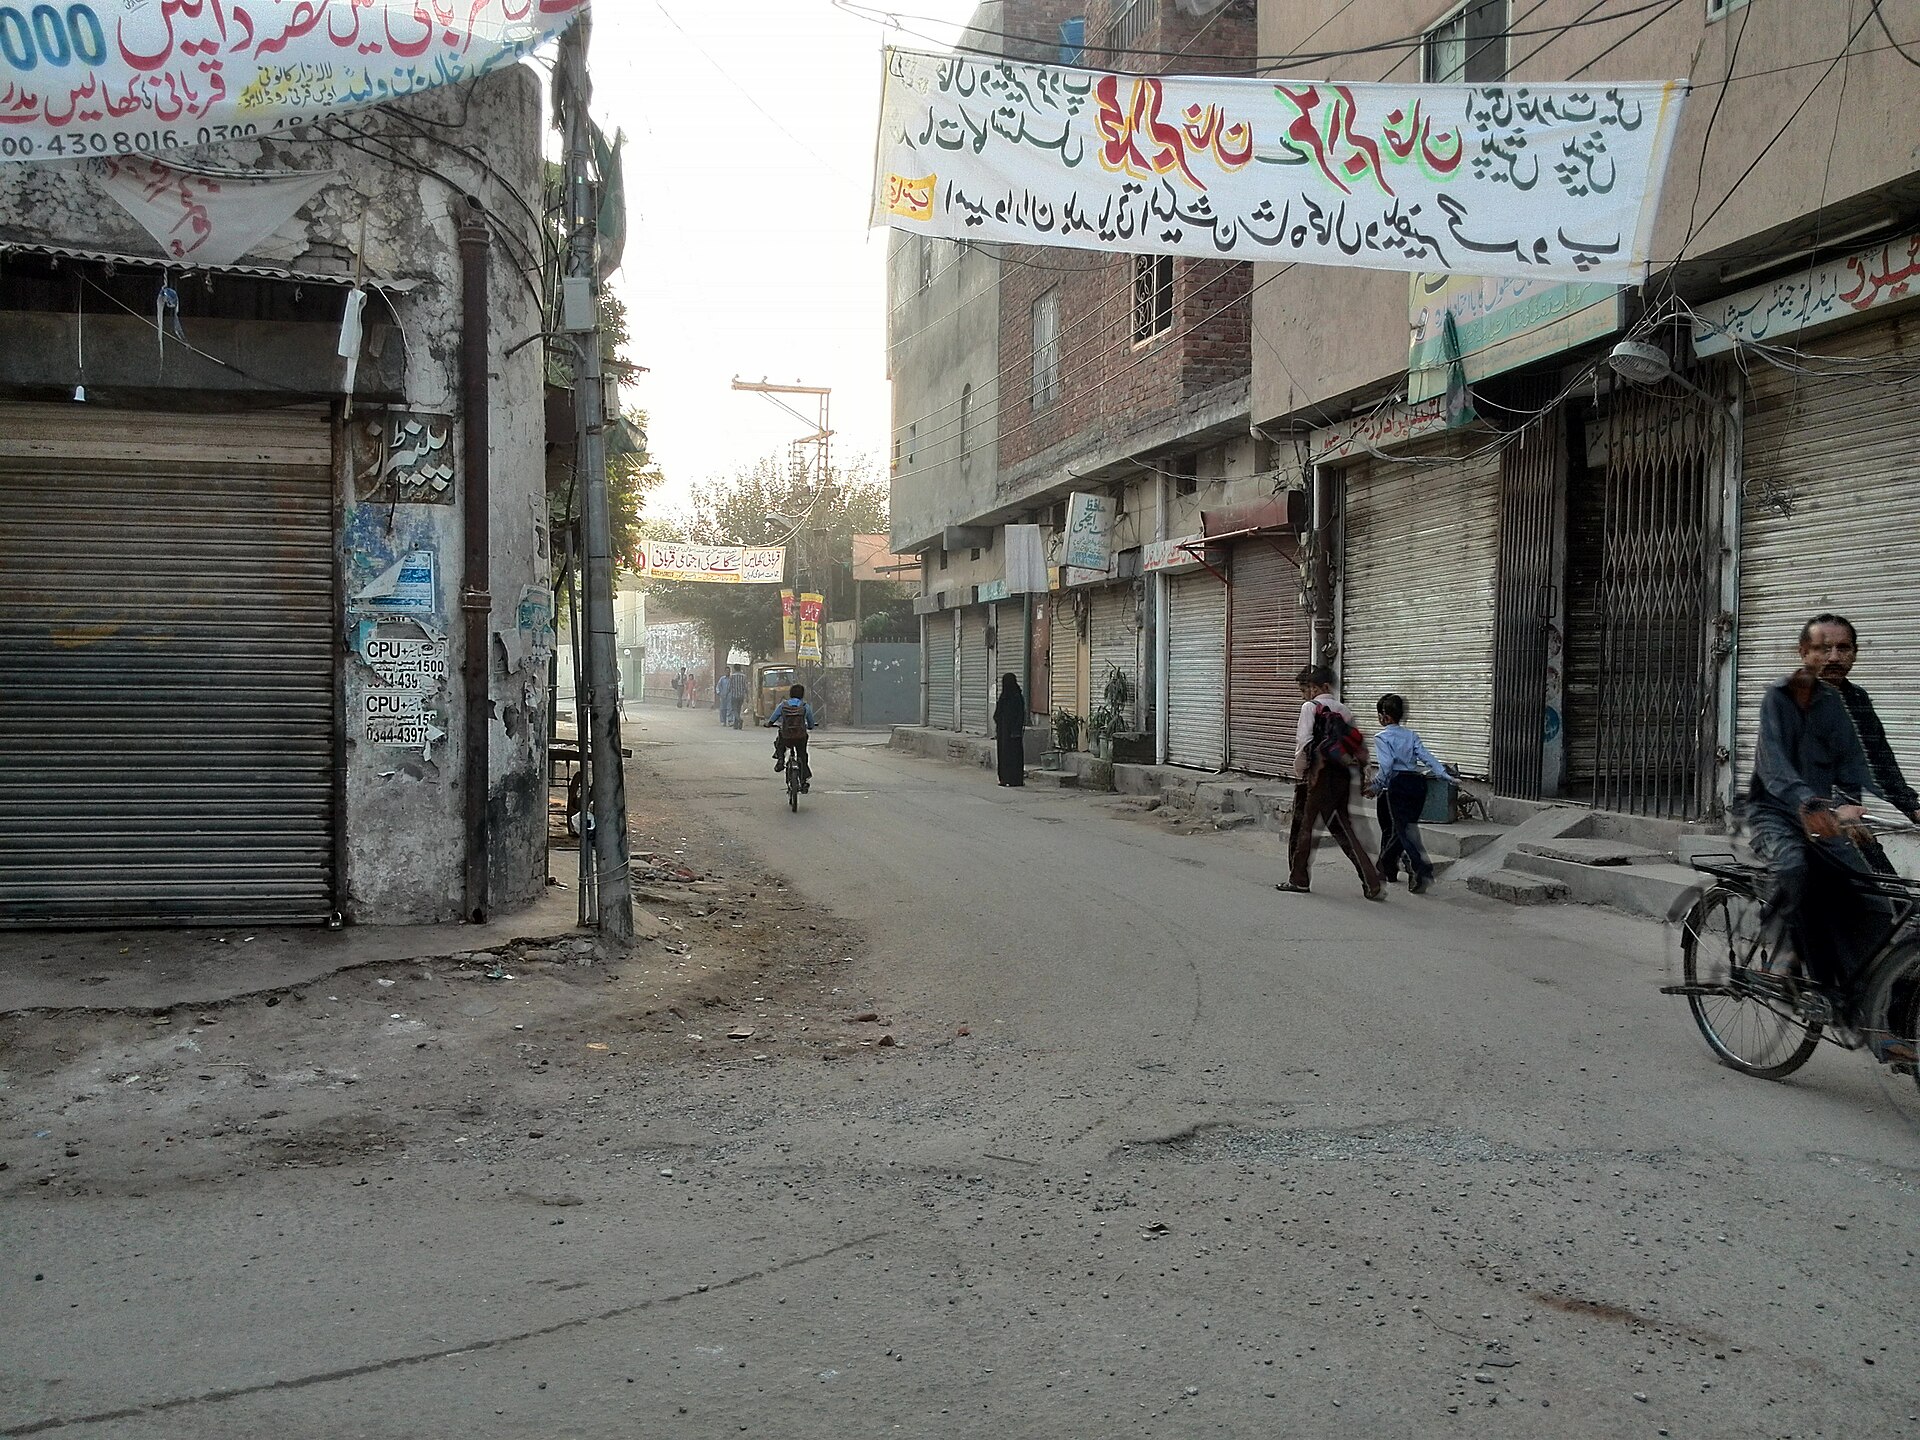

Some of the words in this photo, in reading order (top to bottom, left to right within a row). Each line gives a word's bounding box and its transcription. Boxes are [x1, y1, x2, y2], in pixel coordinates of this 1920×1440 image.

[44, 71, 142, 127] کھالیں
[154, 60, 226, 122] قربانی
[416, 660, 444, 673] 1500
[366, 727, 429, 743] 0344-4397
